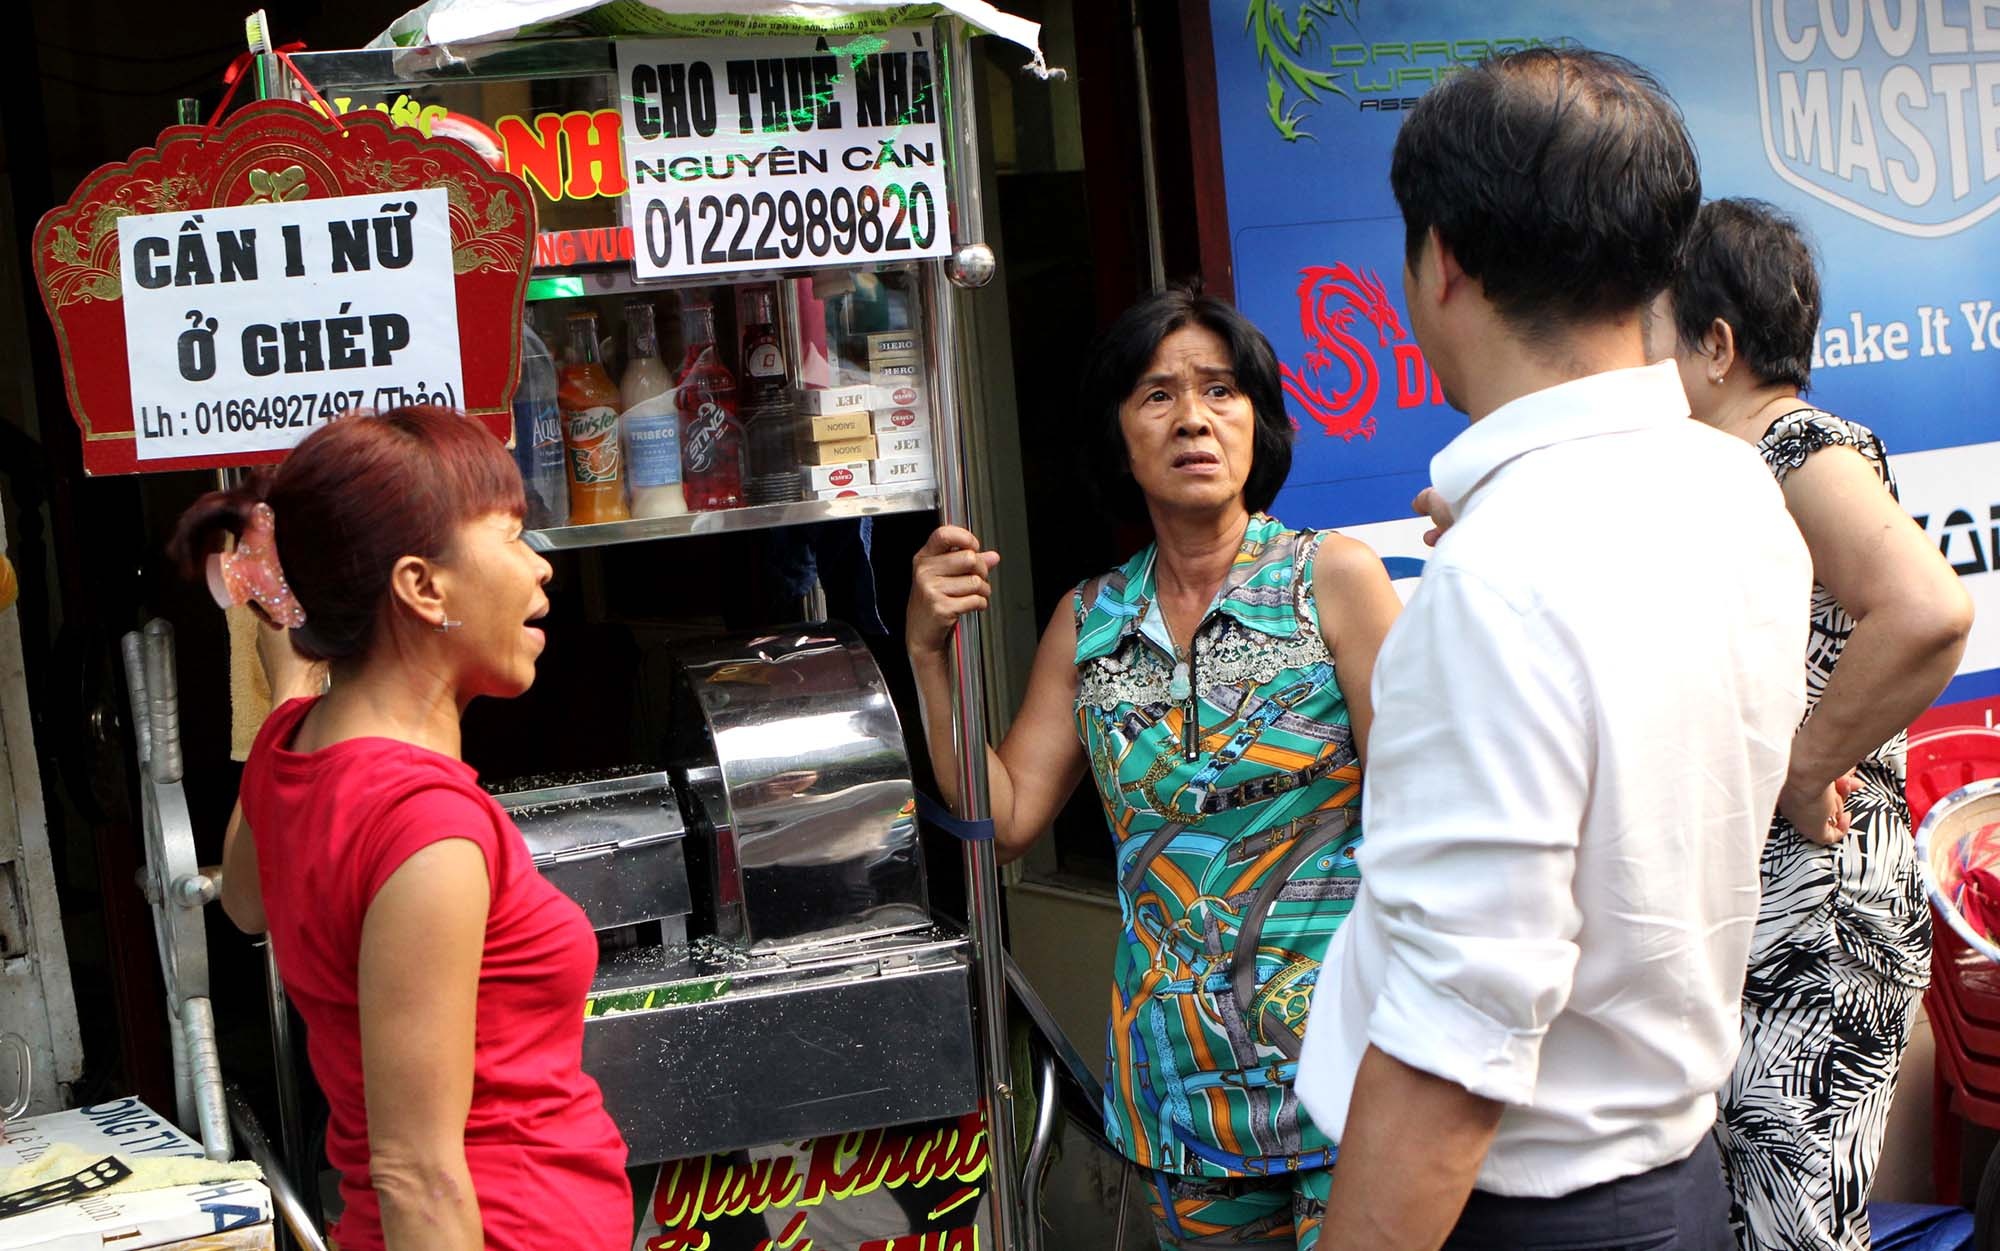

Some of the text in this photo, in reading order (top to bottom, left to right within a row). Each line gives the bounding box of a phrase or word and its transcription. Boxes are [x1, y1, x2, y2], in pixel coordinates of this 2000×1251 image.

[632, 32, 936, 142] CHO THUÊ NHÀ
[635, 143, 830, 186] NGUYÊN
[132, 214, 258, 290] CẦN
[329, 201, 418, 274] NỮ
[643, 181, 935, 270] 01222989820
[176, 302, 411, 383] Ở GHÉP
[1917, 306, 1952, 358] It
[836, 395, 863, 408] JET
[570, 411, 618, 437] Twister
[631, 427, 676, 441] TRIBECO
[894, 438, 921, 451] JET
[890, 462, 919, 475] JET
